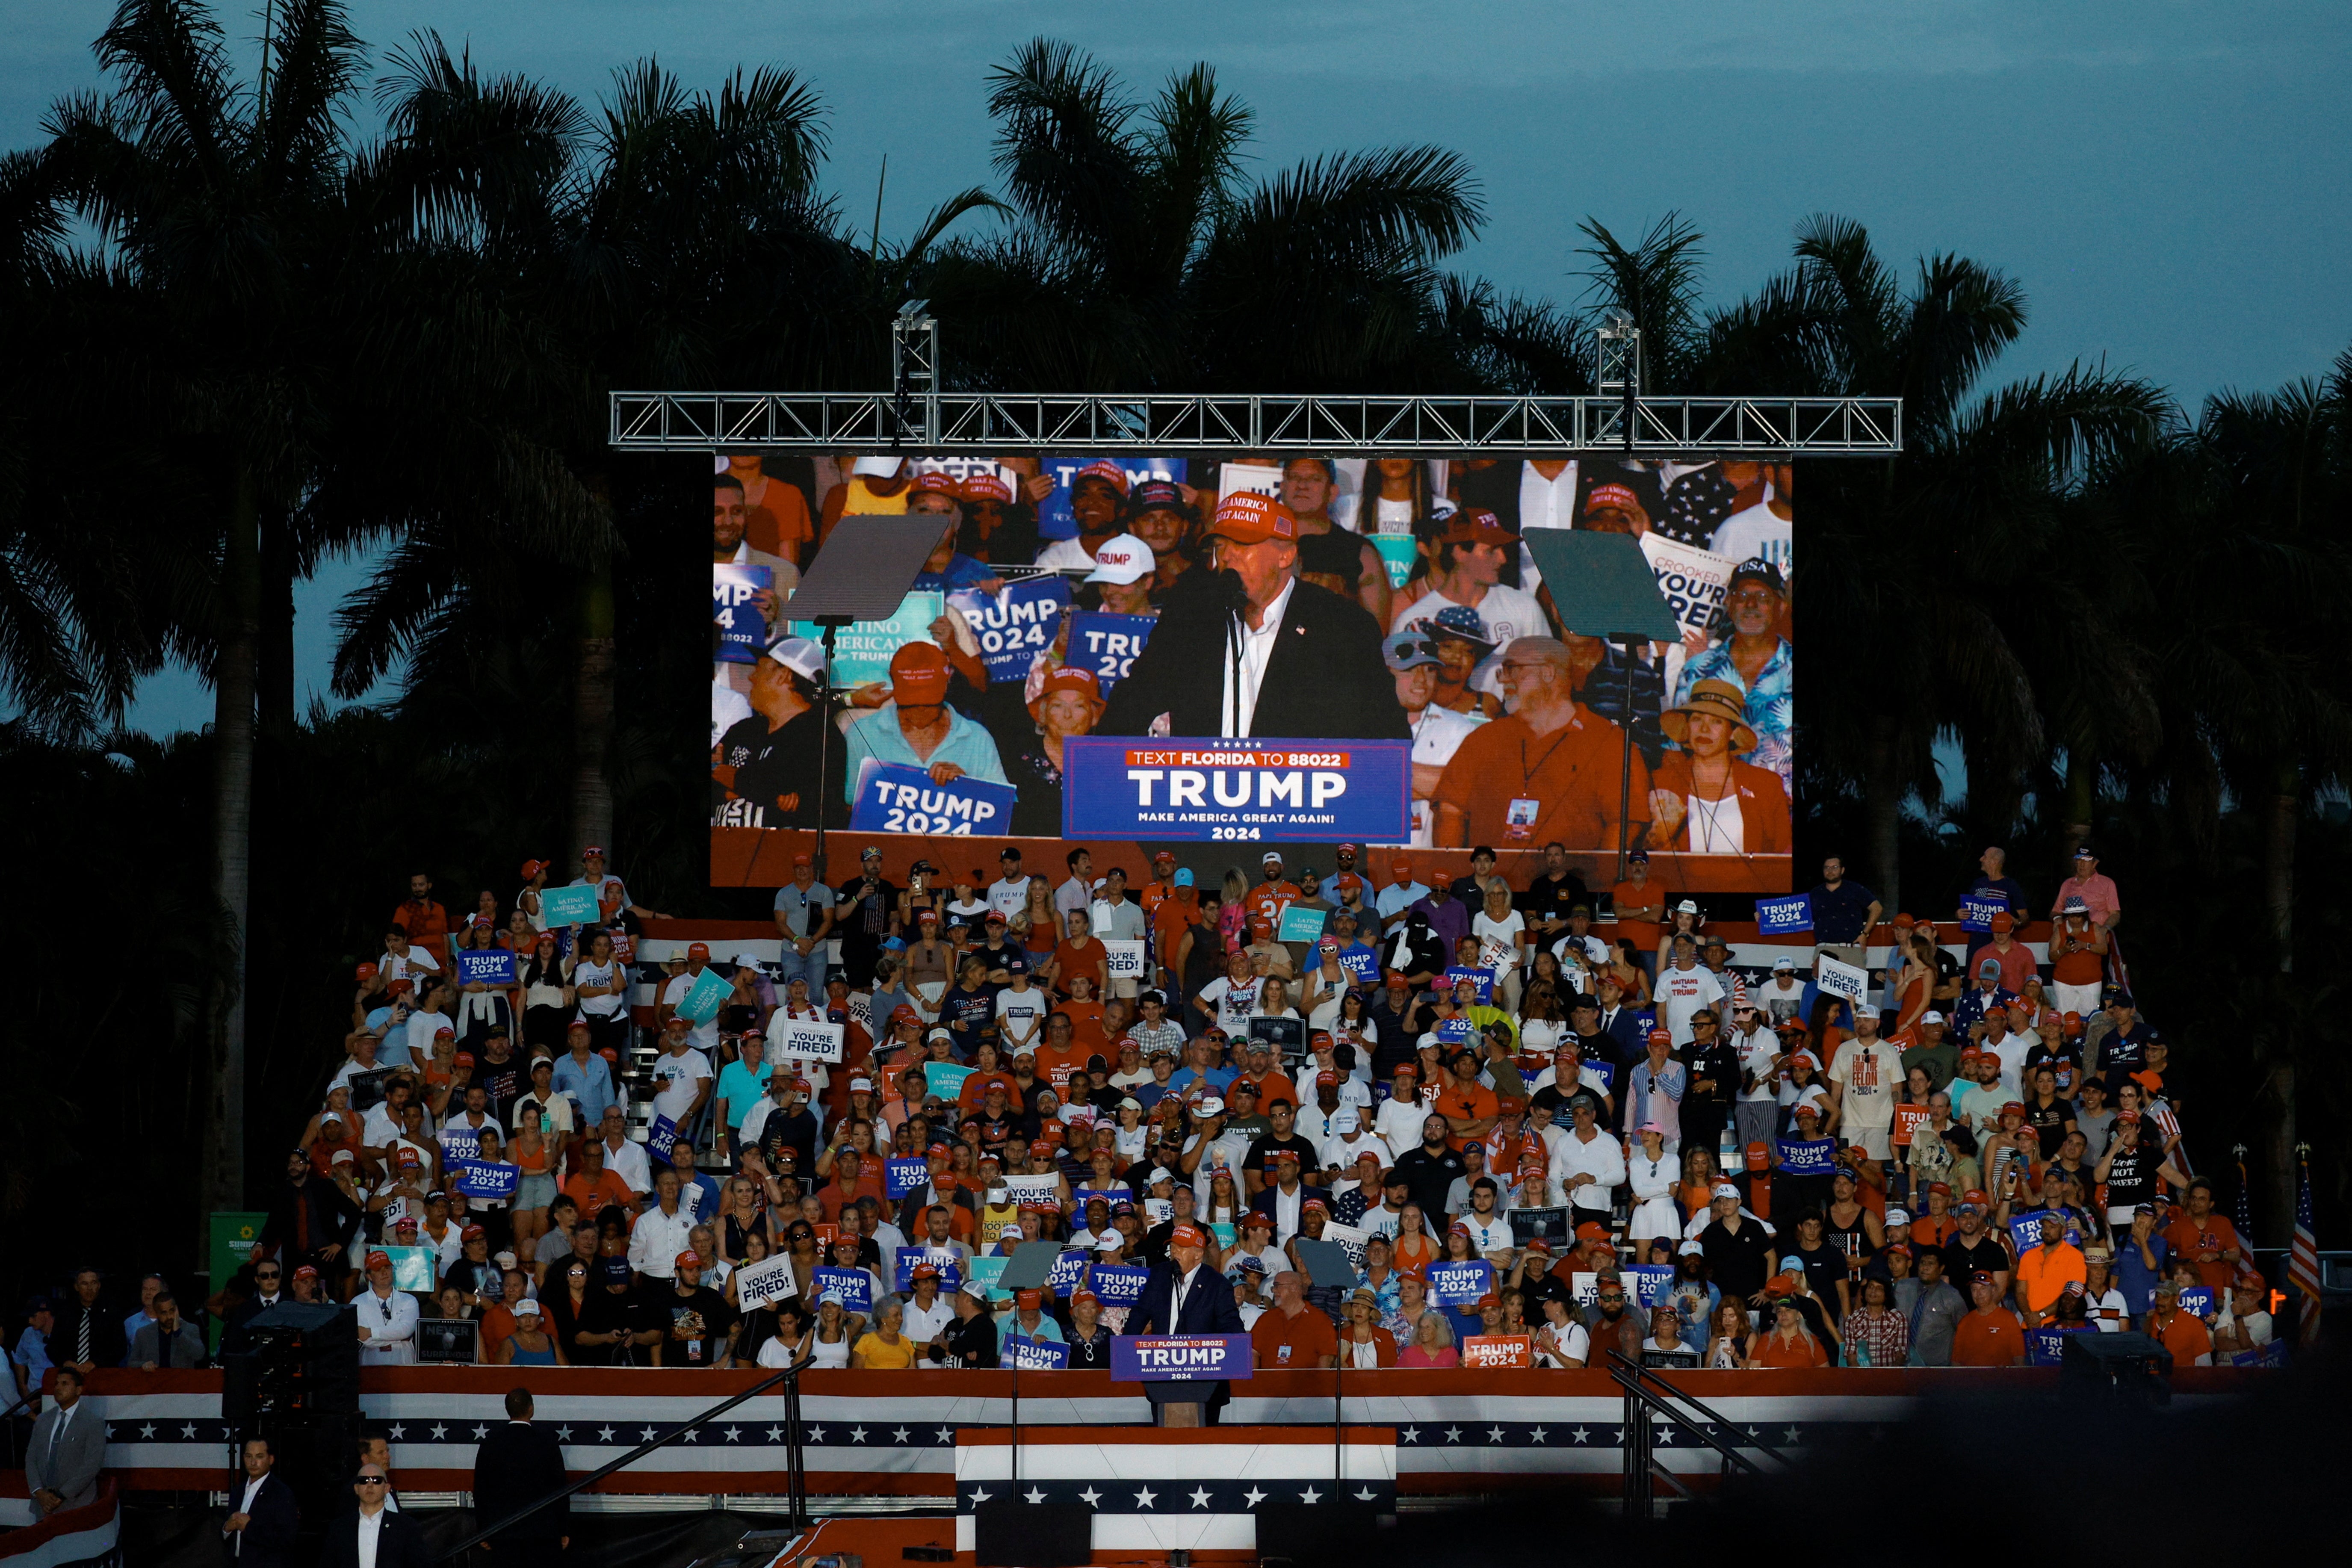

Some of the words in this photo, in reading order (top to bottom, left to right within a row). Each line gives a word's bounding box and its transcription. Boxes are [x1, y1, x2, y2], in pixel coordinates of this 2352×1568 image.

[1056, 466, 1172, 488] TMP
[1227, 497, 1268, 512] AMERICA
[1234, 511, 1261, 524] AGAIN
[1655, 556, 1720, 584] CROOKED
[1739, 561, 1768, 574] USA
[961, 599, 1058, 631] RUMP
[981, 623, 1046, 653] 024
[1085, 631, 1146, 657] TRU
[1016, 652, 1031, 660] TO
[1134, 752, 1177, 765] TEXT
[1181, 752, 1256, 766] FLORIDA
[1260, 753, 1284, 766] TO
[1288, 753, 1341, 767] 88022
[1127, 770, 1347, 808] TRUMP
[875, 780, 996, 823] TRUMP
[883, 808, 972, 835] 2024
[1138, 812, 1176, 822] MAKE
[1179, 812, 1238, 823] AMERICA
[1242, 813, 1284, 823] GREAT
[1288, 814, 1335, 824] AGAIN!
[1211, 827, 1260, 841] 2024
[552, 902, 591, 912] AMERICANS
[558, 897, 584, 905] LATINO
[1762, 901, 1806, 915] TRUMP
[1966, 903, 2004, 913] TRUMP
[920, 913, 936, 921] TRUMP
[1770, 912, 1801, 924] 2024
[1972, 911, 1992, 921] 202
[611, 935, 629, 948] RUMP
[615, 944, 629, 954] 2024
[464, 956, 509, 966] TRUMP
[1108, 961, 1138, 970] RED!
[1337, 955, 1371, 966] RUMP
[470, 964, 502, 974] 2024
[1449, 974, 1490, 984] TRUMP
[1826, 969, 1860, 987] YOU'RE
[1229, 988, 1254, 996] TRUMP
[1822, 975, 1862, 998] FIRED!
[1257, 1022, 1296, 1031] NEVER
[792, 1032, 833, 1043] YOU'RE
[788, 1040, 836, 1055] FIRED!
[2110, 1042, 2138, 1056] TRMP
[1853, 1062, 1864, 1072] FOR
[1853, 1072, 1878, 1087] FELON
[1858, 1086, 1872, 1096] 2024
[1049, 1125, 1063, 1133] MAG
[1782, 1146, 1829, 1156] TRUMP
[1790, 1155, 1823, 1164] 2024
[465, 1166, 513, 1180] TRUMP
[2112, 1168, 2134, 1177] NOT
[470, 1176, 505, 1187] 2024
[899, 1176, 930, 1186] 2024
[2109, 1177, 2142, 1187] SHEEP
[428, 1190, 445, 1199] TRUMP
[1012, 1187, 1053, 1198] YOU'RE
[1078, 1197, 1128, 1207] TMP
[1518, 1213, 1561, 1224] NEVER
[904, 1256, 954, 1268] TRUMP
[1052, 1261, 1083, 1274] UMP
[745, 1267, 771, 1281] CROOKED
[745, 1268, 784, 1289] YOU'RE
[1051, 1273, 1077, 1285] 024
[1096, 1273, 1147, 1286] TRUMP
[1433, 1269, 1483, 1282] TRUMP
[819, 1274, 867, 1288] TRUMP
[1439, 1281, 1477, 1292] 2024
[743, 1276, 790, 1303] FIRED!
[1102, 1284, 1139, 1296] 2024
[426, 1326, 469, 1336] NEVER
[421, 1350, 473, 1360] SURRENDER
[1010, 1344, 1062, 1361] TRUMP
[1471, 1344, 1525, 1356] TRUMP
[1016, 1356, 1053, 1370] 2024
[1137, 1349, 1226, 1366] TRUMP
[1480, 1354, 1517, 1366] 2024
[1646, 1355, 1690, 1368] NEVER
